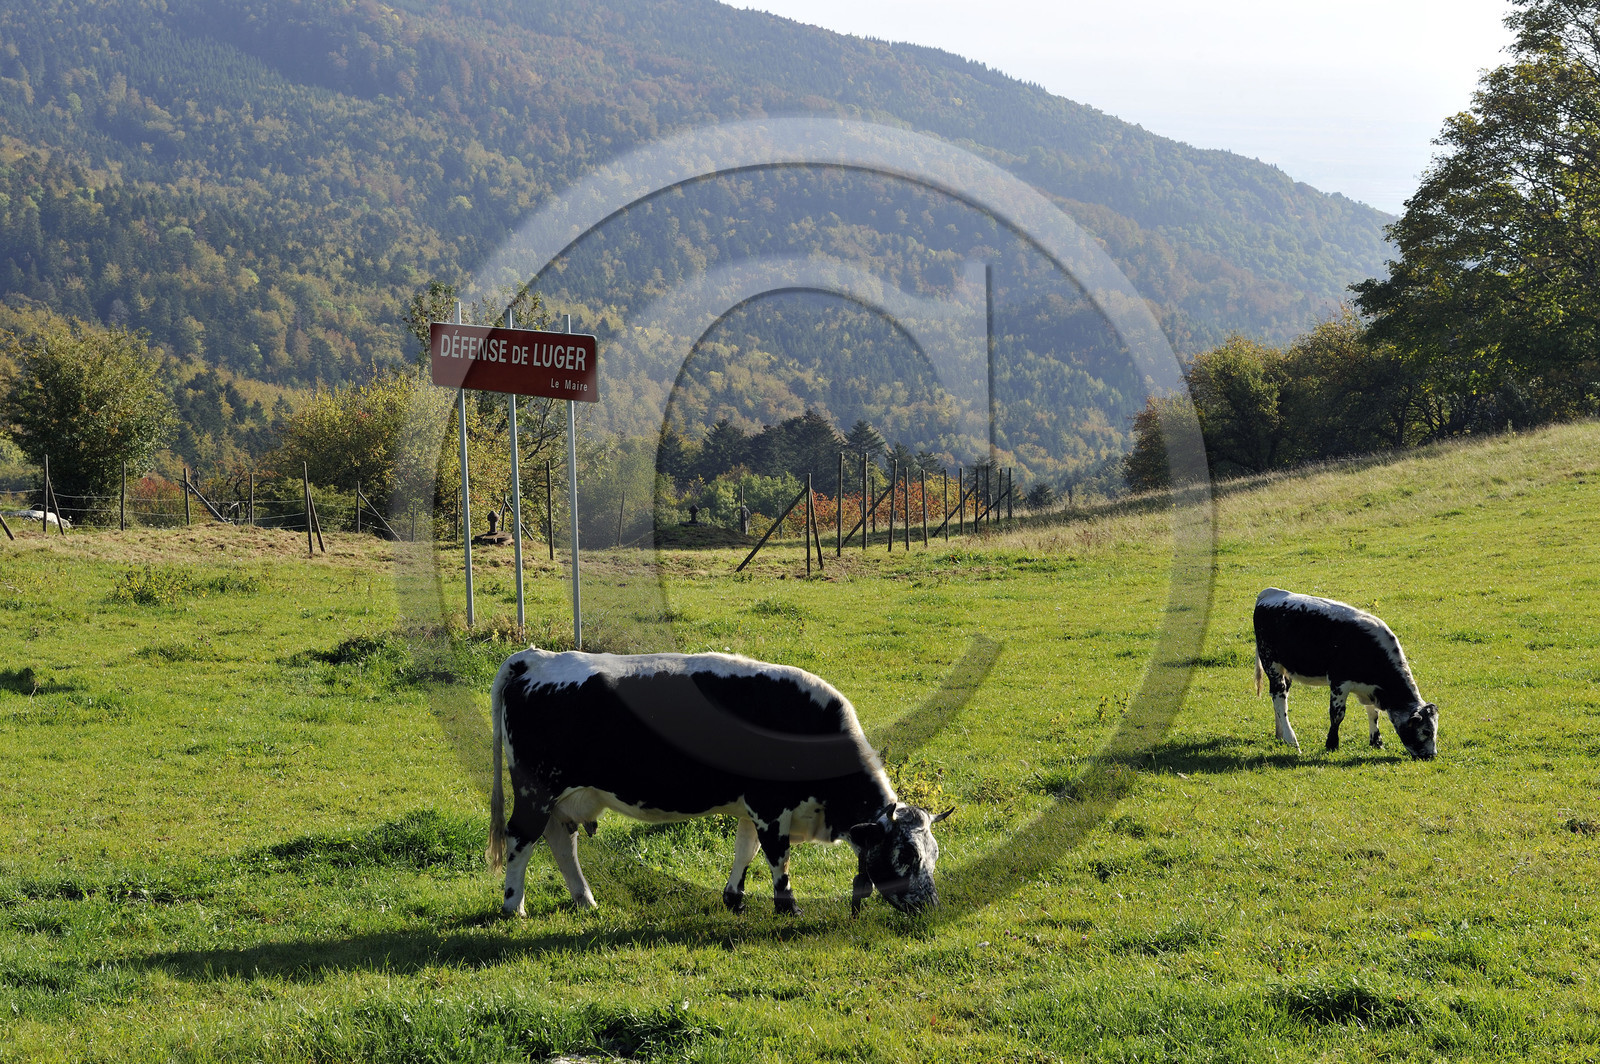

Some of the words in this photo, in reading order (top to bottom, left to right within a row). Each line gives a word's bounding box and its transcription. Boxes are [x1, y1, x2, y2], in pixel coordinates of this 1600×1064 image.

[440, 330, 508, 363] DÉFENSE
[511, 345, 529, 366] DE
[533, 343, 587, 371] LUGER
[550, 378, 560, 389] Le
[564, 379, 588, 392] Maire
